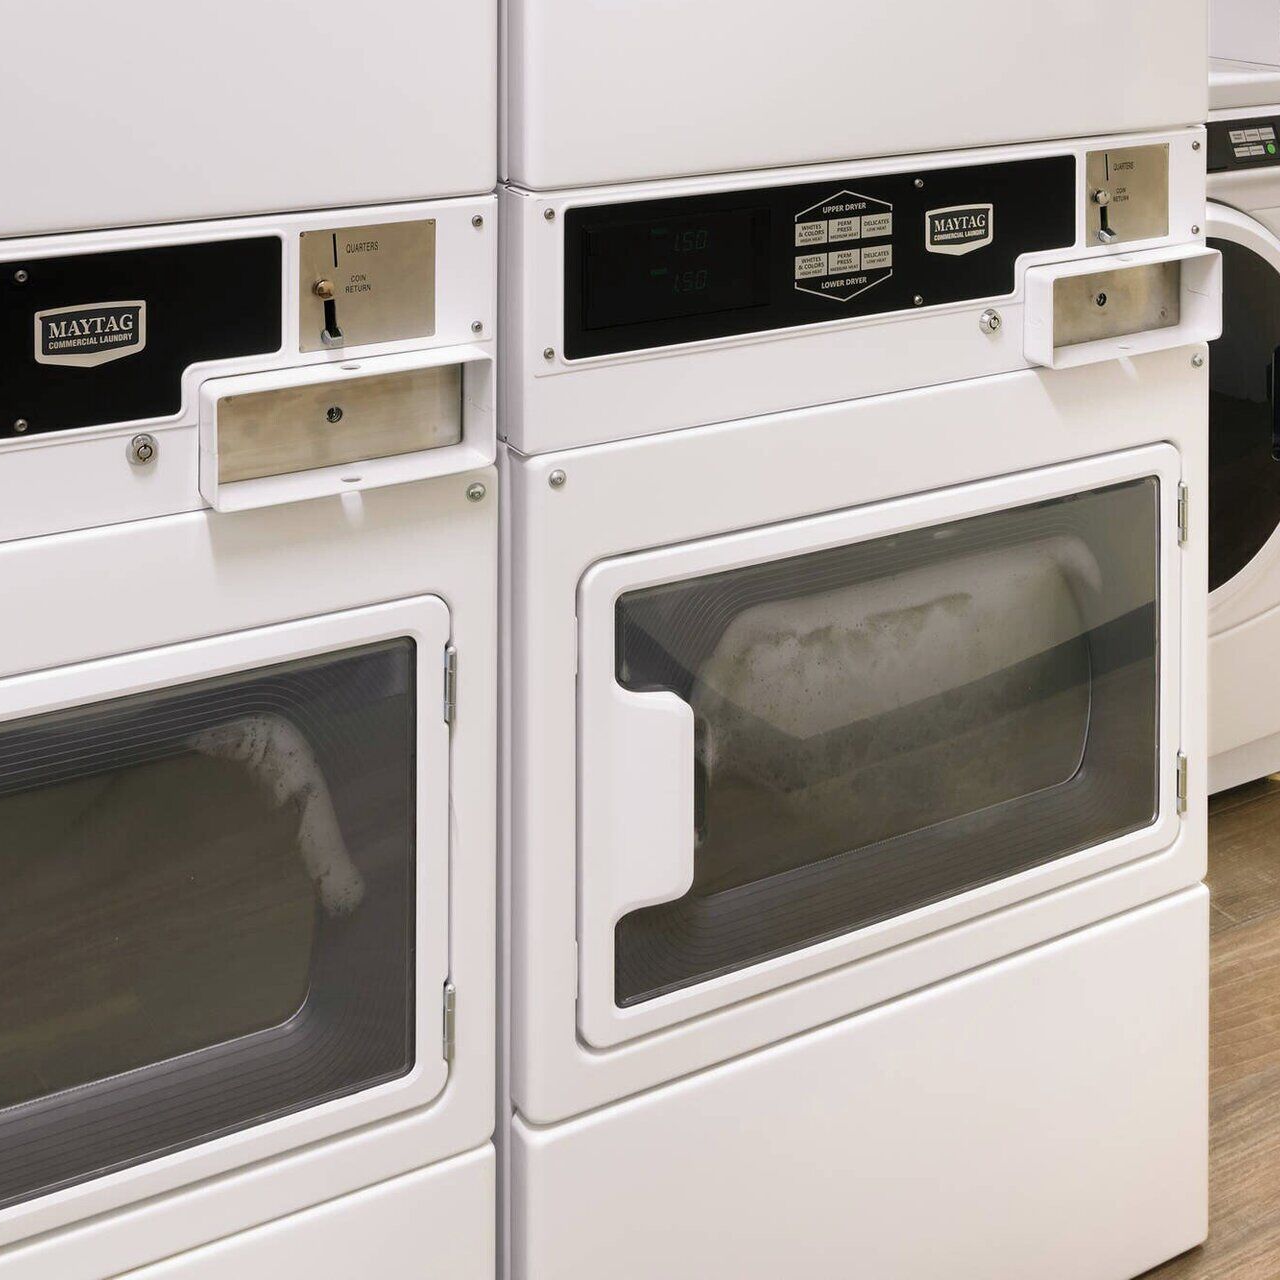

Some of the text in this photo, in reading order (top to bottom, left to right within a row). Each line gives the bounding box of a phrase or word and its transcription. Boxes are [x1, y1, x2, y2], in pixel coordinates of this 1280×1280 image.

[822, 202, 867, 214] UPPER DRYER
[934, 214, 986, 232] MAYTAG
[346, 241, 379, 254] QUARTERS
[351, 274, 366, 283] COIN
[821, 277, 867, 289] LOWER DRYER
[345, 284, 371, 293] RETURN
[48, 314, 133, 339] MAYTAG
[48, 332, 133, 350] COMMERCIAL LAUNDRY
